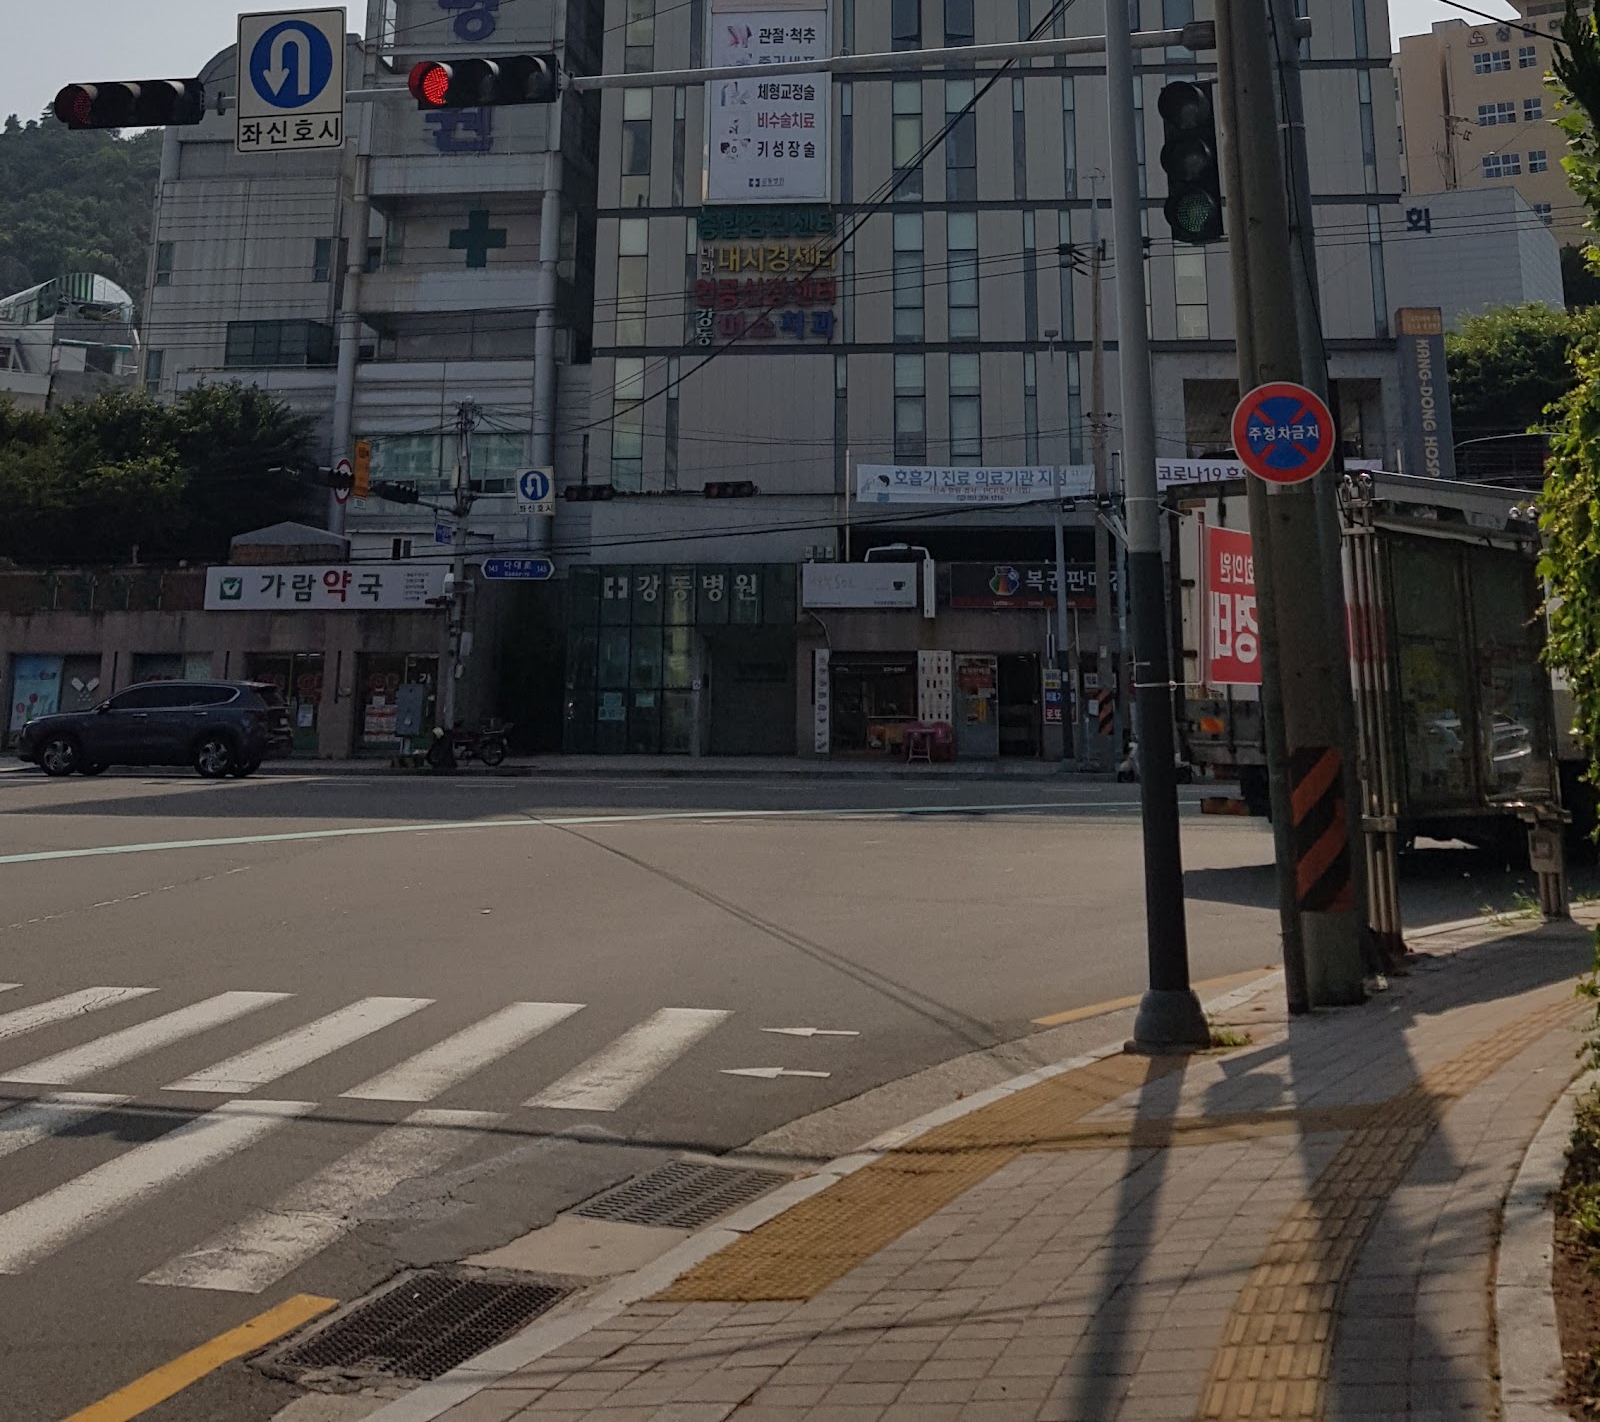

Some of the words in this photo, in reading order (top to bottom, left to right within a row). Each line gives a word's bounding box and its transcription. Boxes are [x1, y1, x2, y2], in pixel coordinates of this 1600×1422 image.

[757, 83, 815, 101] 체형교정술
[757, 112, 816, 129] 비수술치료
[241, 117, 339, 145] 좌신호시
[1415, 338, 1438, 432] KANG-DONG
[1248, 424, 1319, 441] 주정차금지
[894, 468, 937, 487] 호흡기
[942, 470, 969, 487] 진료
[975, 470, 1034, 486] 의료기관
[1158, 466, 1221, 484] 코로나19
[260, 570, 383, 603] 가람약국
[636, 574, 758, 603] 강동병원
